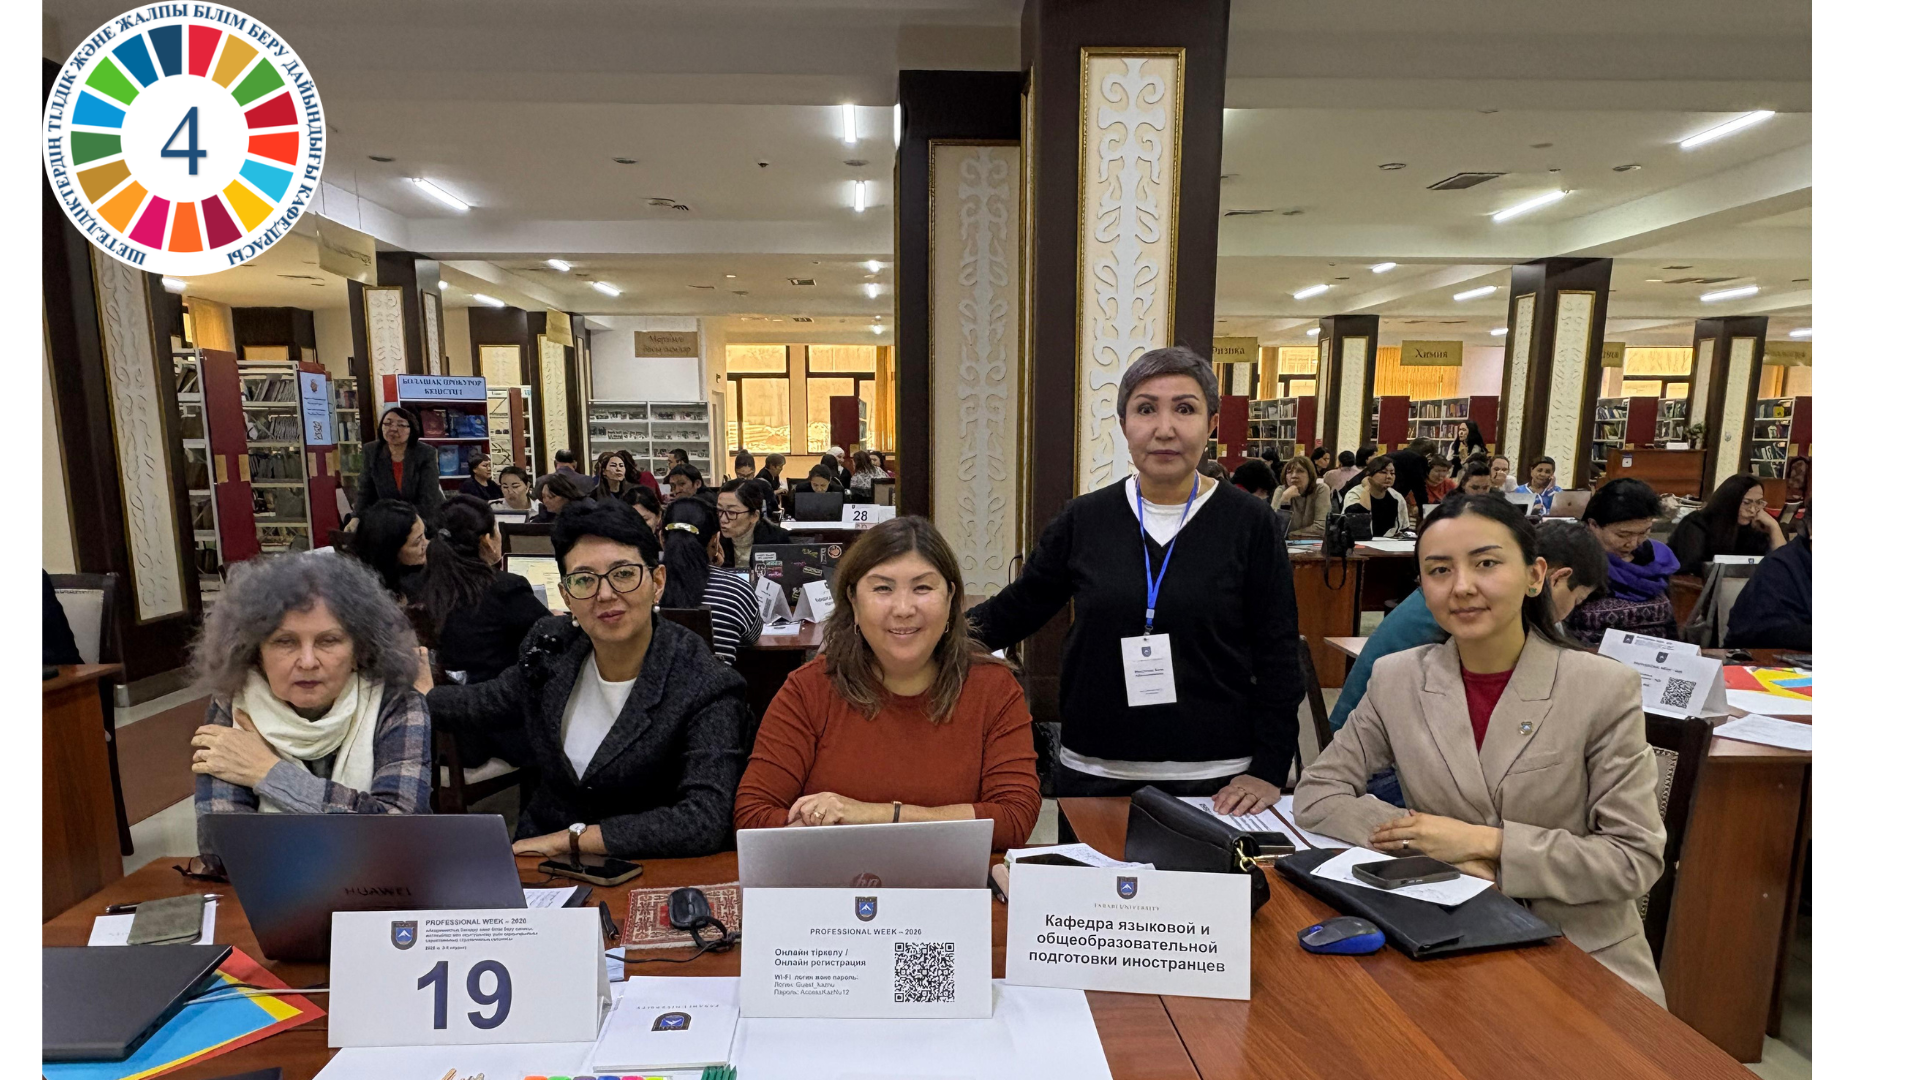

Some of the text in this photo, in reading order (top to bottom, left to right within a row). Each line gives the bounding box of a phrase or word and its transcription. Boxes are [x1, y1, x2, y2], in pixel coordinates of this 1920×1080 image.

[853, 510, 868, 521] 28
[344, 887, 412, 896] HUAWEI
[1045, 913, 1210, 936] Кафедра языковой и
[1036, 932, 1218, 954] общеобразовательной
[774, 948, 809, 956] Онлайн
[774, 958, 866, 968] Онлайн регистрация
[1028, 951, 1226, 973] подготовки иностранцев
[418, 960, 512, 1029] 19
